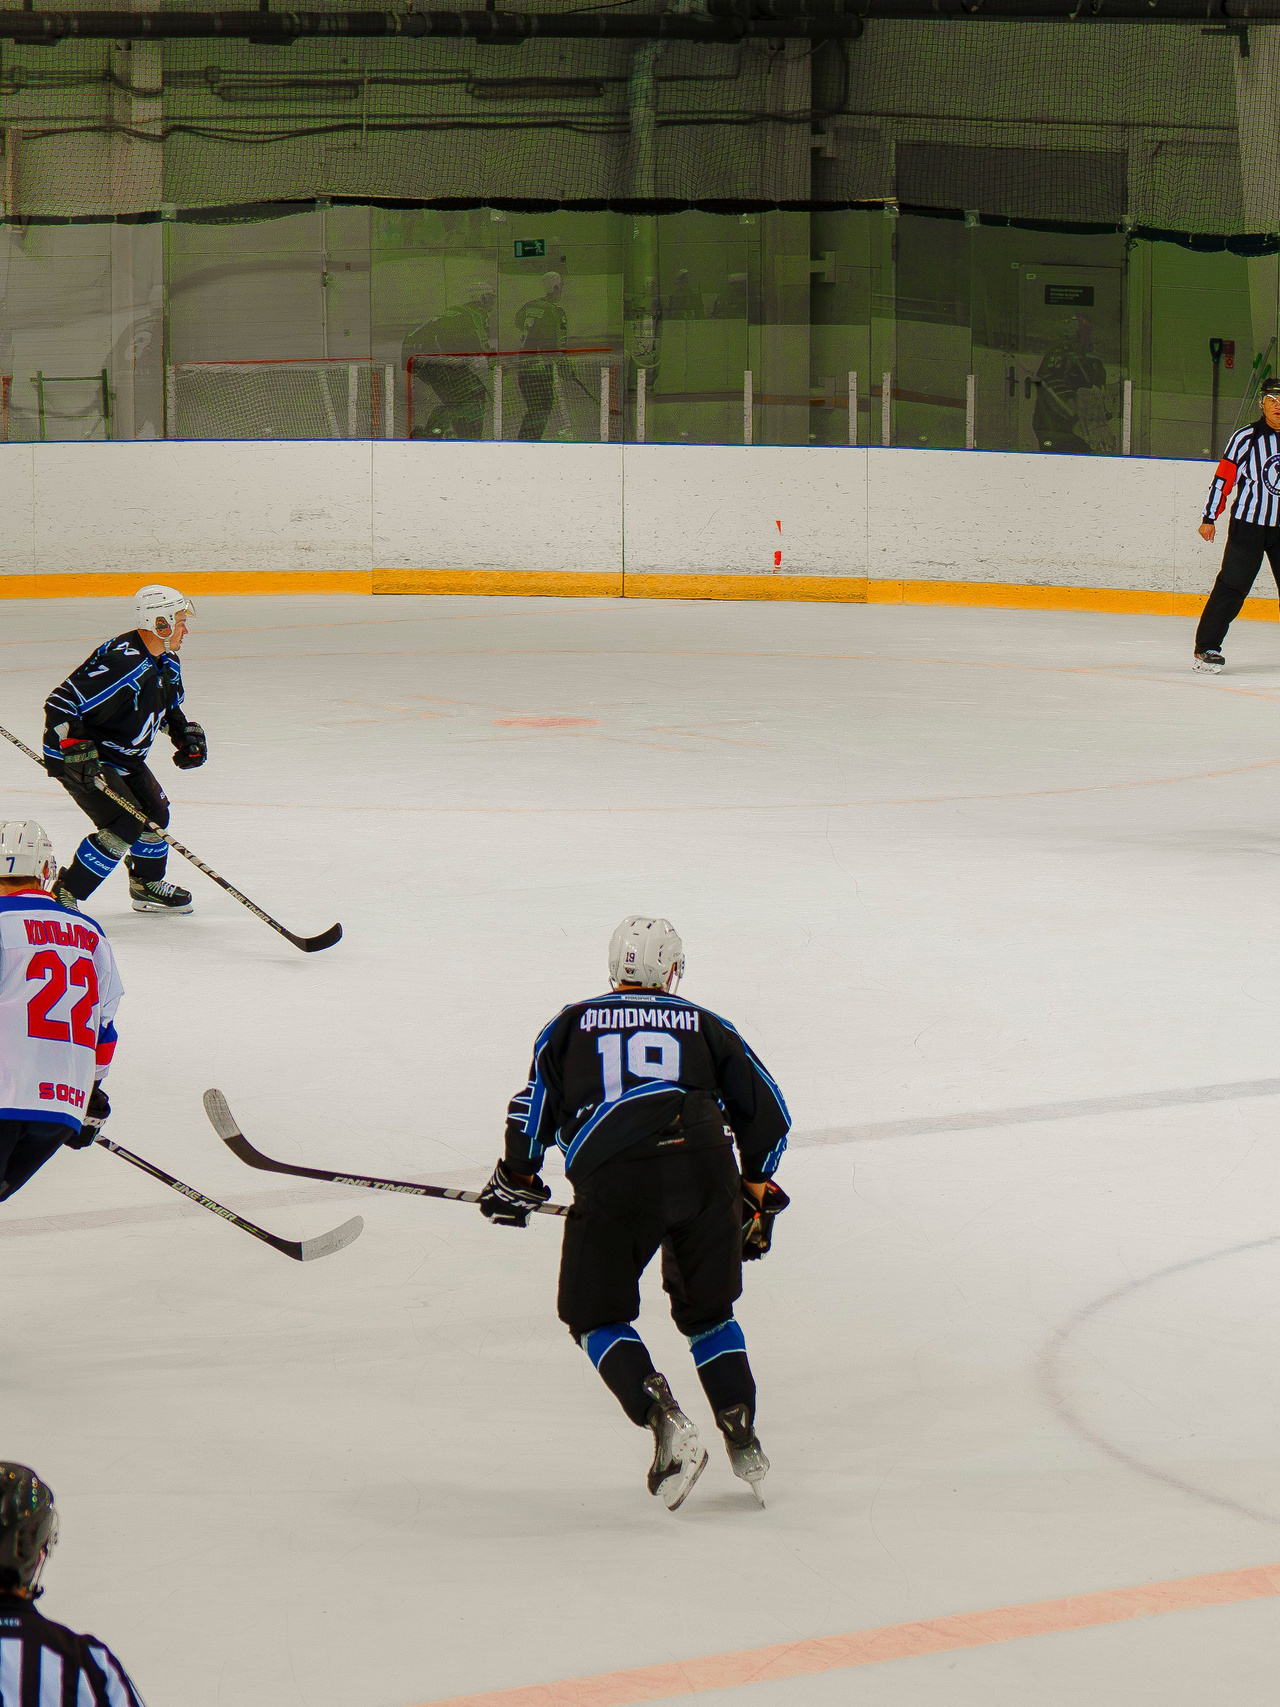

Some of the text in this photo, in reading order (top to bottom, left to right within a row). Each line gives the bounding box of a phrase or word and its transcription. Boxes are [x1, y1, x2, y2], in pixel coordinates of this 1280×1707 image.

[5, 856, 16, 873] 7
[625, 952, 636, 963] 19
[26, 950, 100, 1050] 22
[580, 1008, 700, 1033] ФОЛОМКИН
[596, 1031, 682, 1103] 19
[372, 1181, 427, 1196] TIMER
[199, 1196, 238, 1222] TIMER
